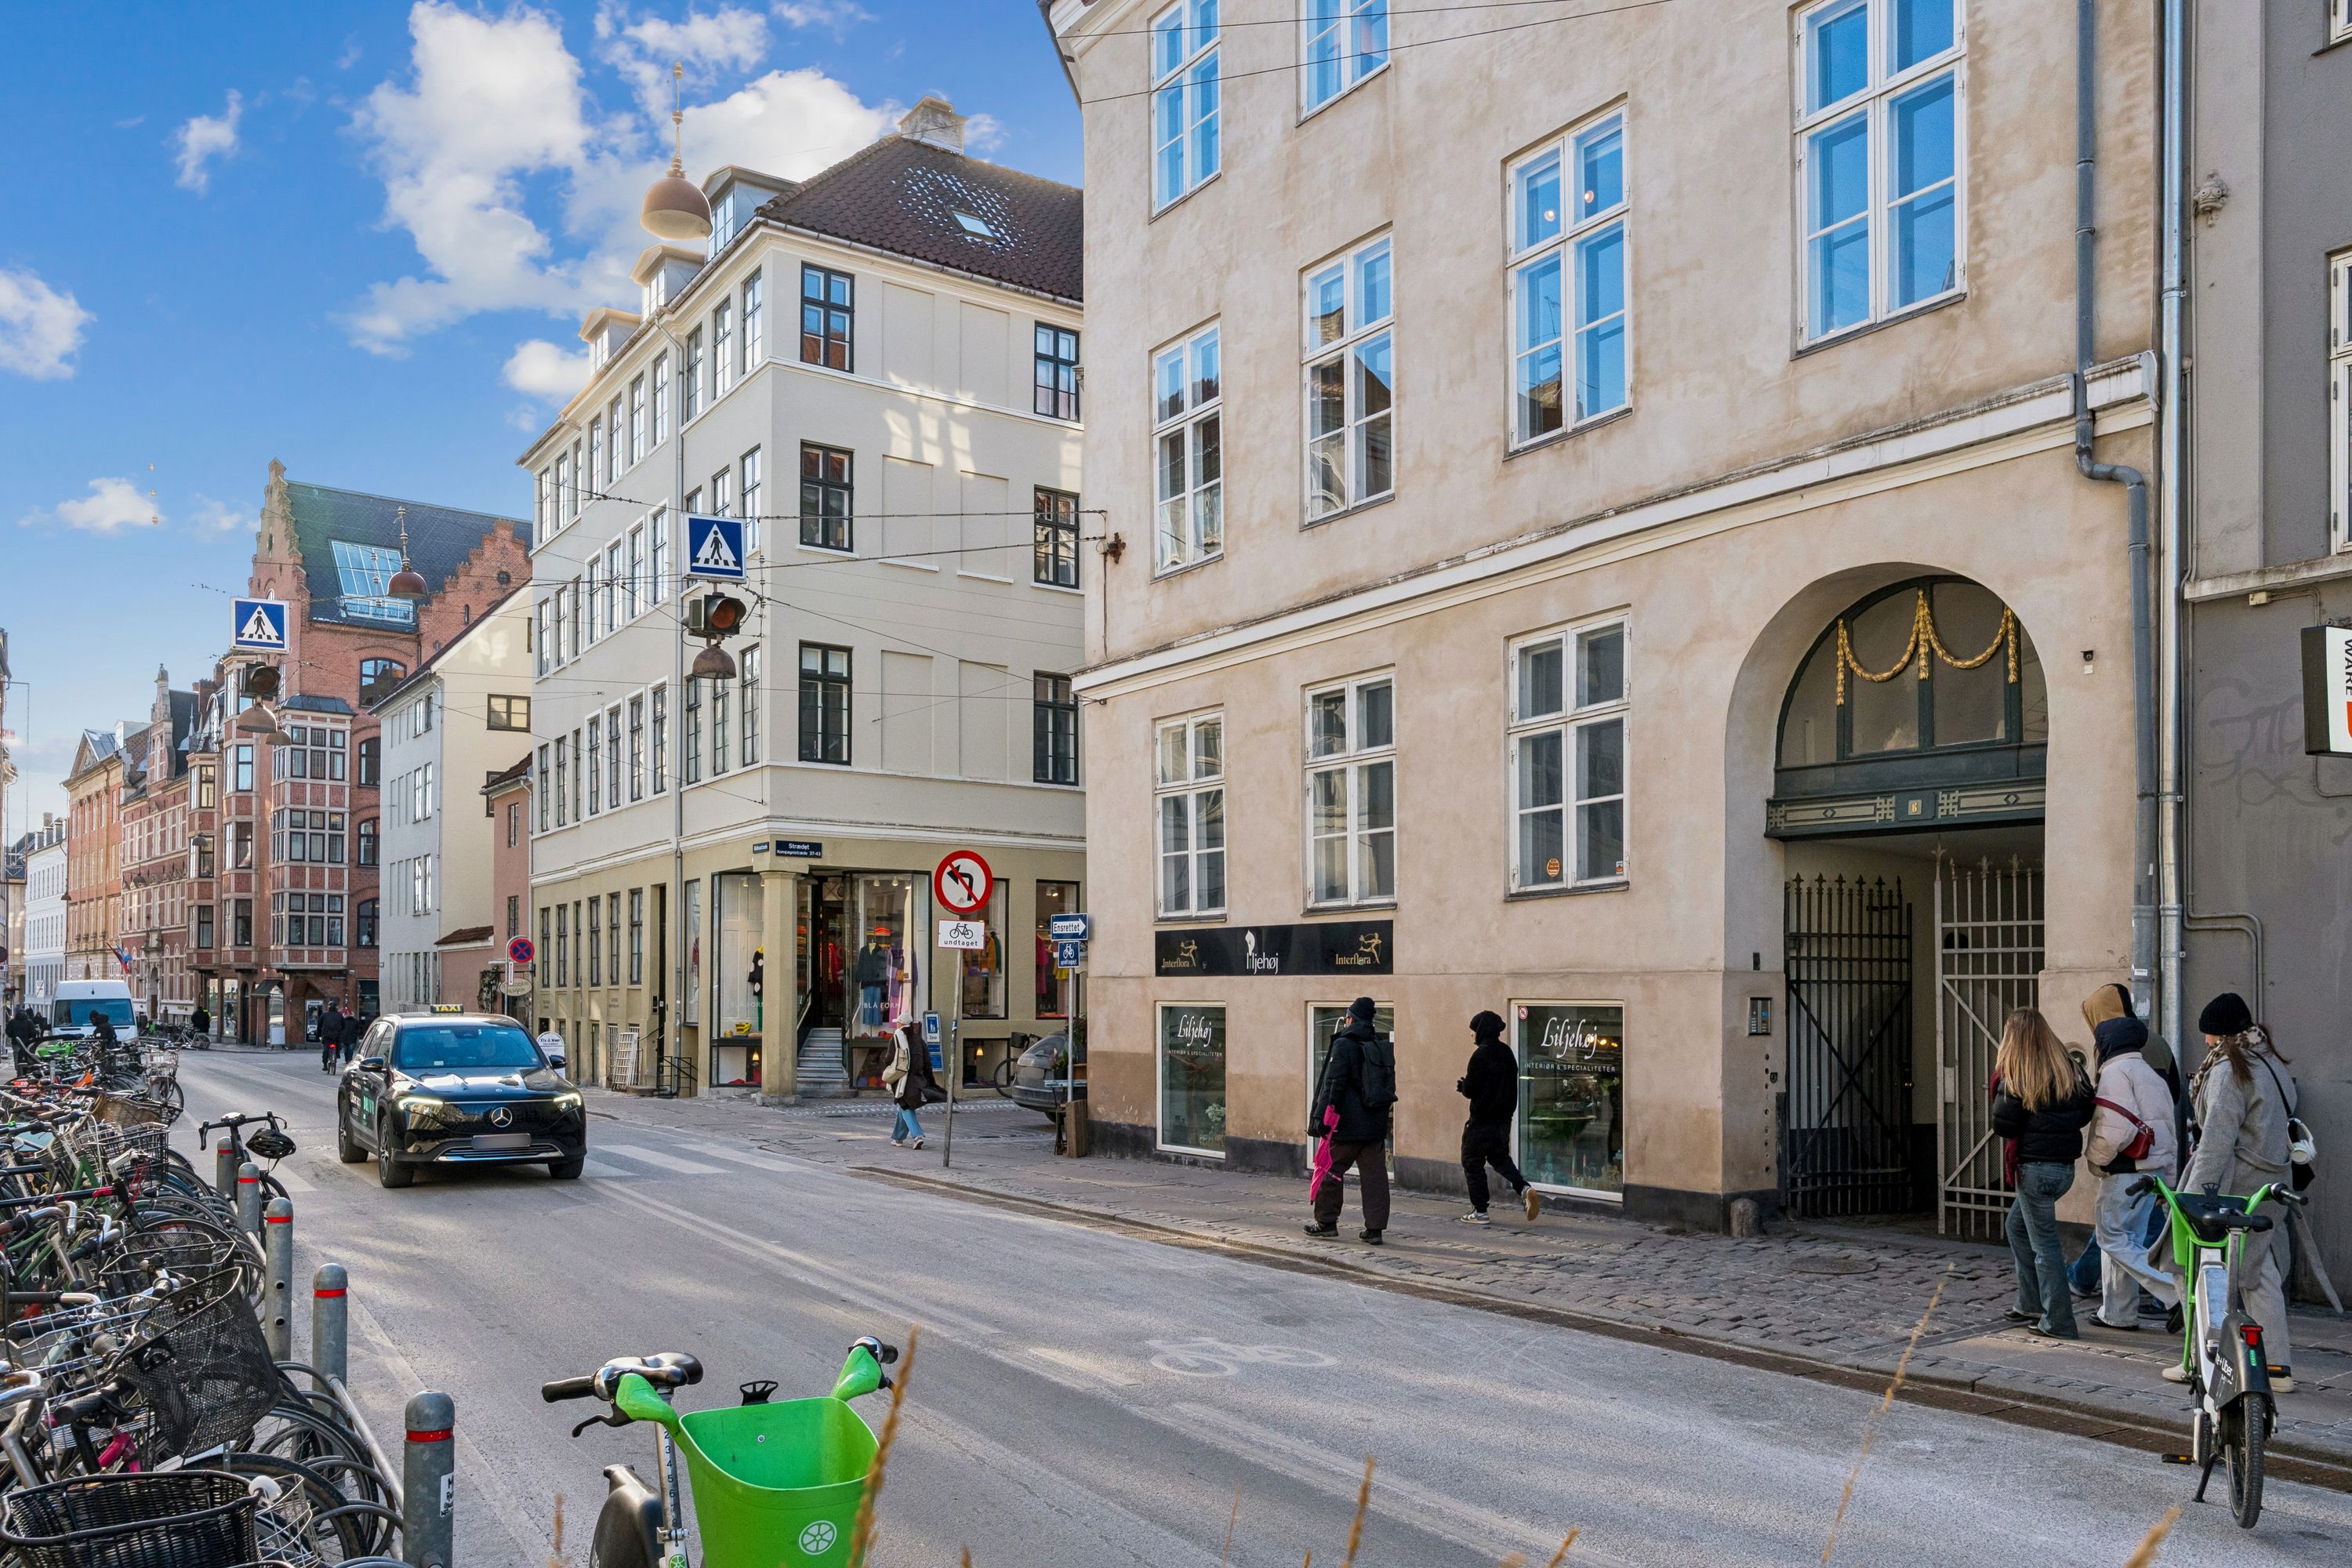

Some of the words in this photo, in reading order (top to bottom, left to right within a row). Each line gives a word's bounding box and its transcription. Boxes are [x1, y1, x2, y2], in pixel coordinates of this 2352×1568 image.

[1911, 801, 1918, 813] 6
[1054, 923, 1080, 932] Ensrettet
[1161, 957, 1190, 968] Interflora
[1247, 952, 1279, 975] liljehøj
[1336, 953, 1371, 965] Interflora
[1177, 1014, 1212, 1047] Liljehøj
[1541, 1017, 1598, 1060] Liljehøj
[1563, 1064, 1616, 1073] SPECIALITETER
[666, 1459, 672, 1468] 4
[669, 1490, 675, 1498] 6
